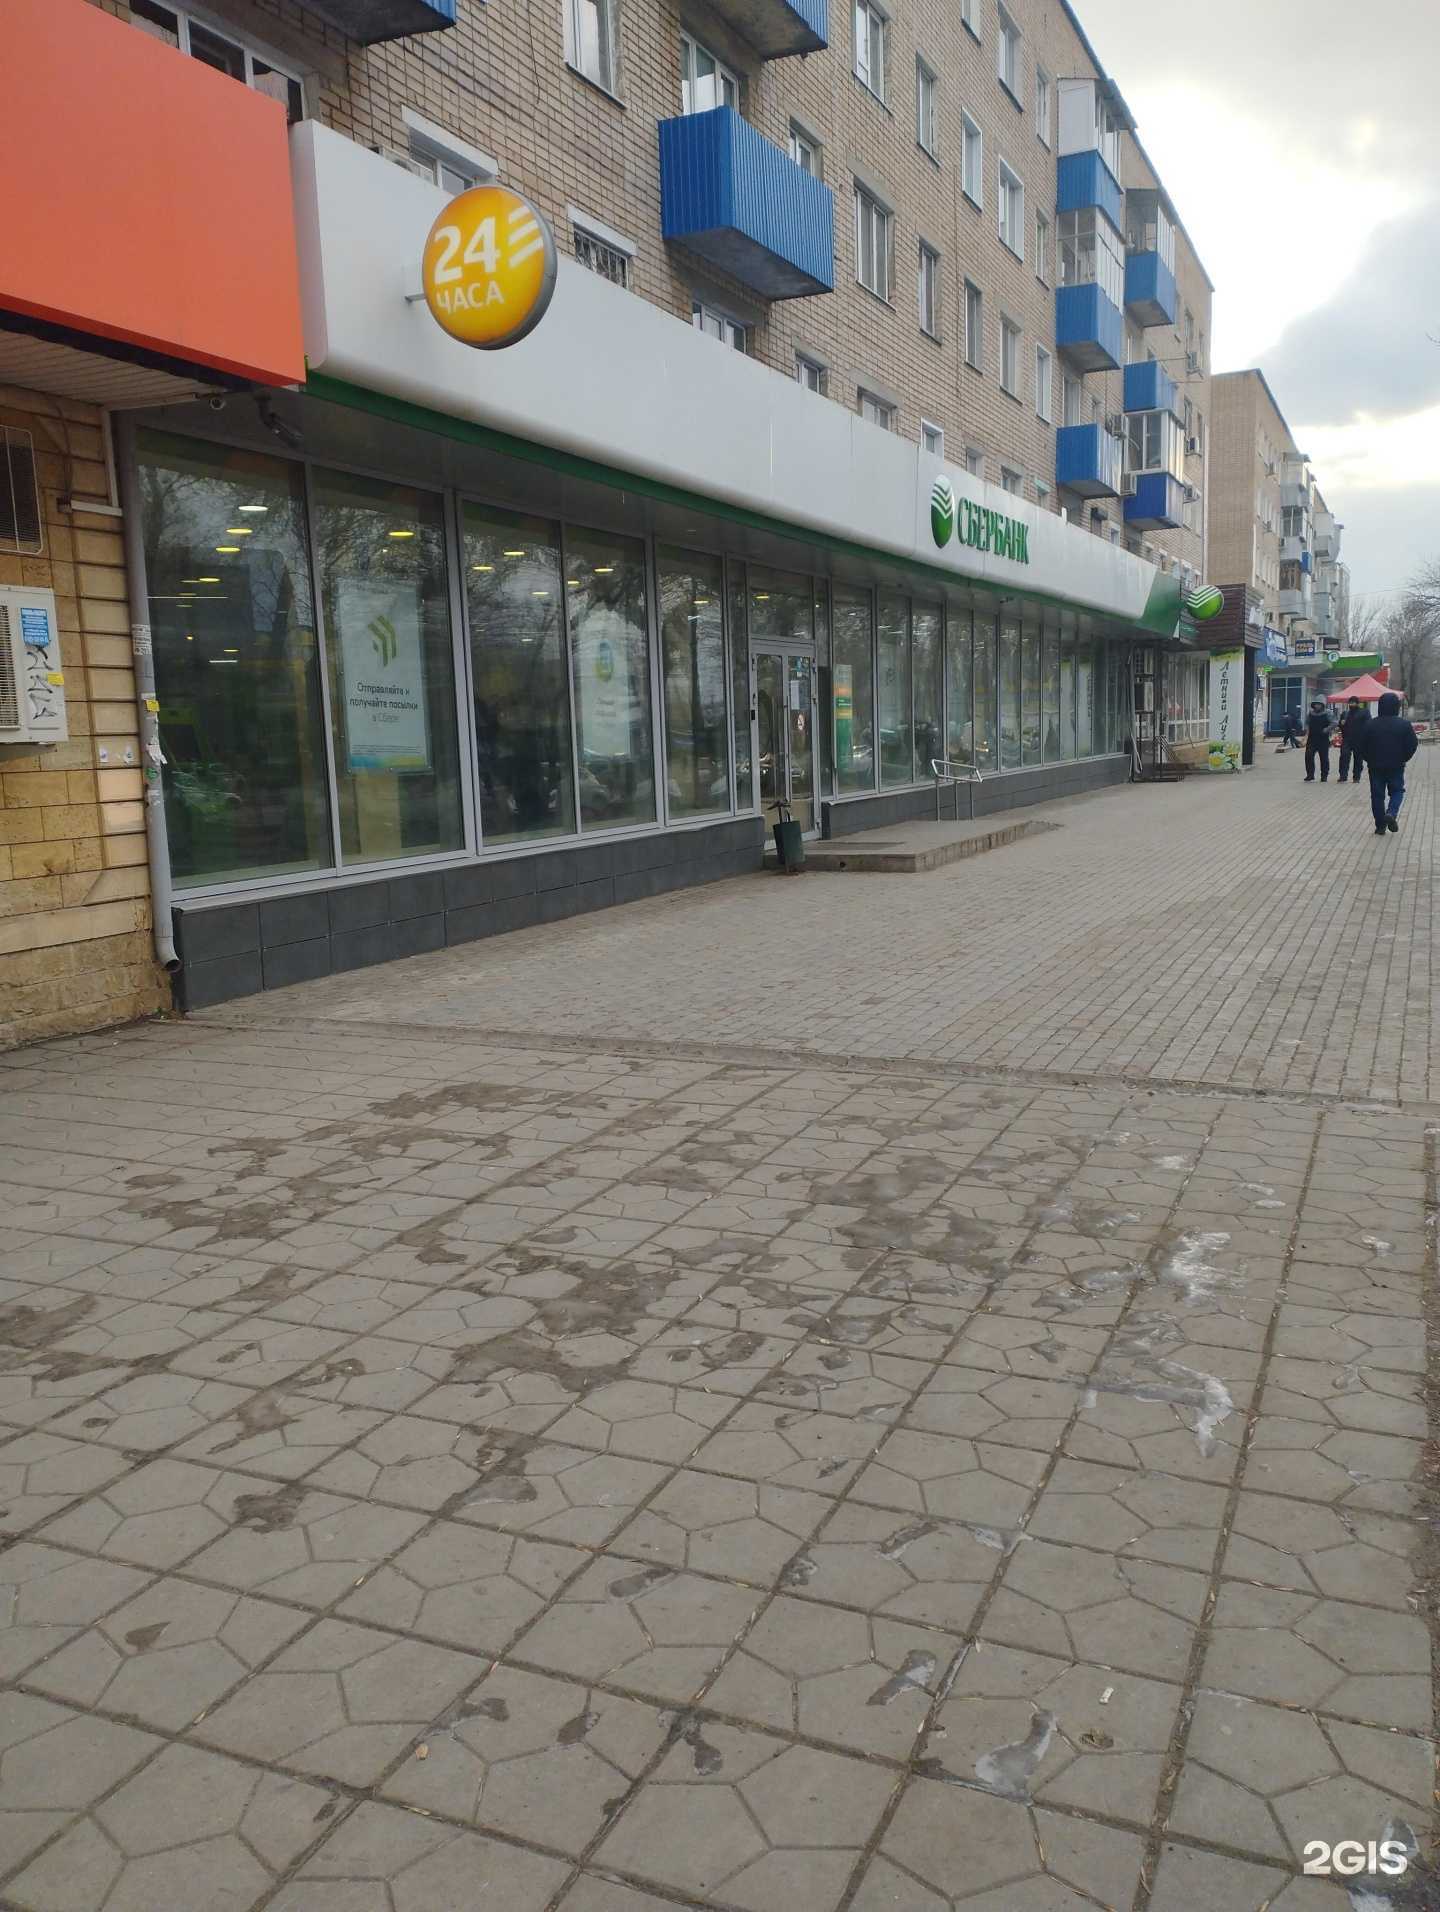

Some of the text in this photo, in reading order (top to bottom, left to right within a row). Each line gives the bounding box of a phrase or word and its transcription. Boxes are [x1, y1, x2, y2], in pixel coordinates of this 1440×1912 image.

[433, 216, 500, 285] 24
[436, 280, 505, 315] ЧАСА
[957, 496, 1030, 565] СБЕРБАНК
[350, 697, 418, 712] получайте посылки
[357, 681, 403, 696] Отправляйте
